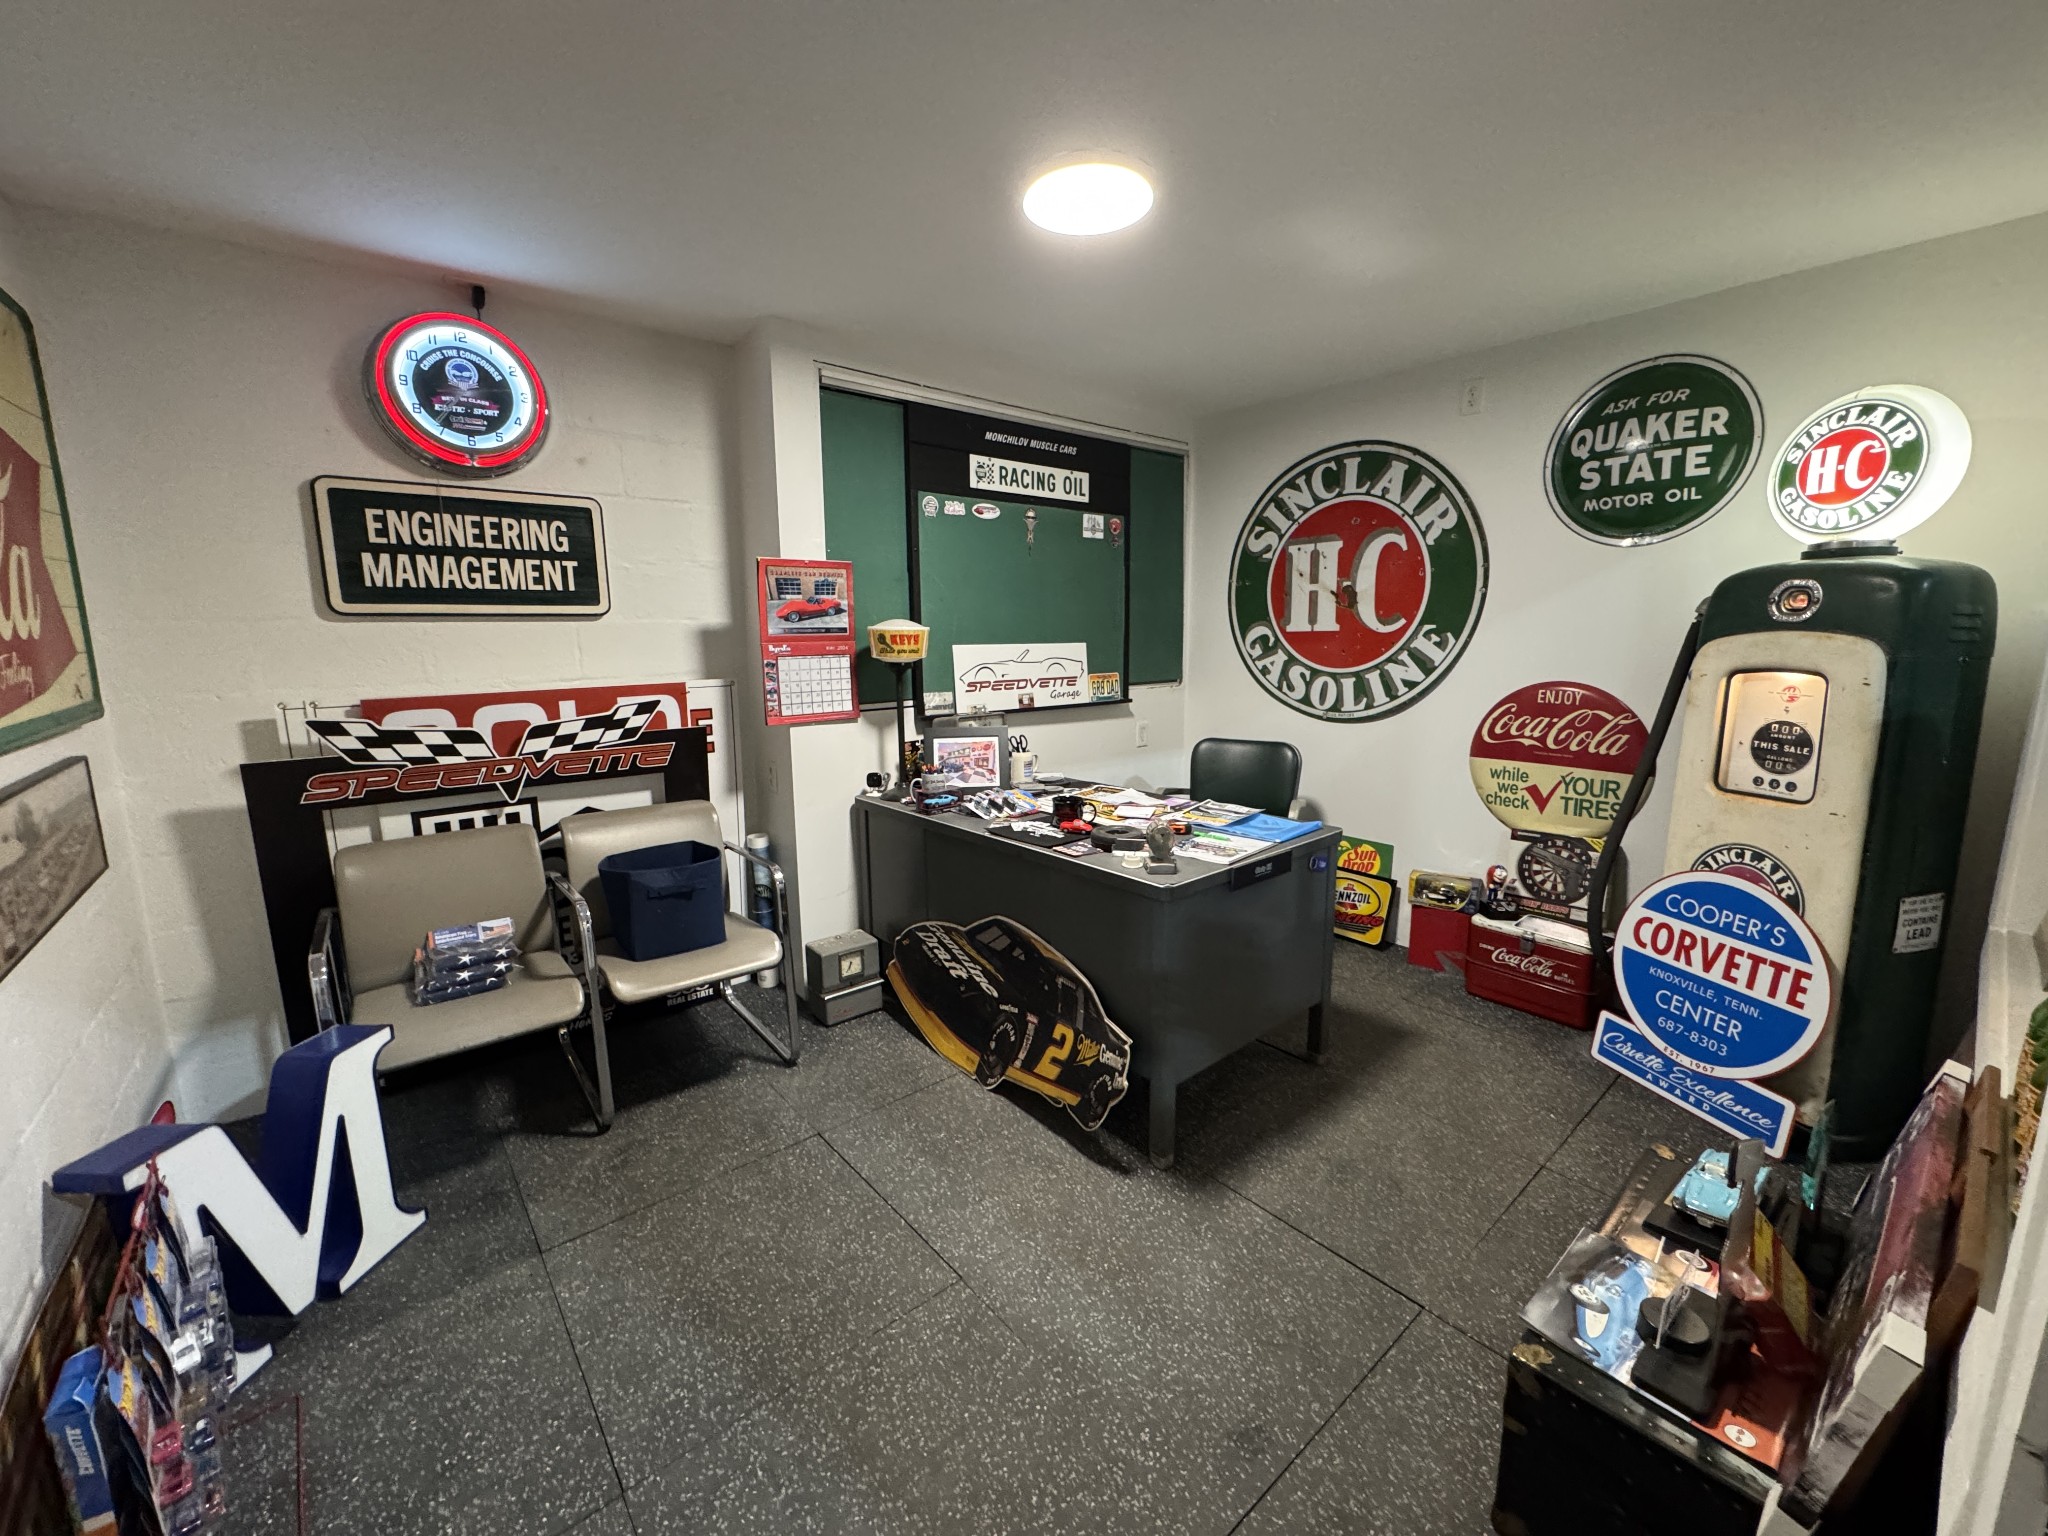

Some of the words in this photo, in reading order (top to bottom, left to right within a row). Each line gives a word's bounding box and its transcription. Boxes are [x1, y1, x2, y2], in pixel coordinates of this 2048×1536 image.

[428, 334, 437, 345] 11
[454, 331, 467, 343] 12
[406, 350, 419, 361] 10
[490, 345, 493, 355] 1
[420, 350, 444, 371] CRUISE
[442, 349, 458, 358] THE
[460, 350, 503, 382] CONCOURSE
[509, 366, 518, 377] 2
[399, 374, 408, 386] 9
[412, 403, 422, 414] 8
[473, 408, 500, 417] SPORT
[1601, 396, 1643, 417] ASK
[1646, 388, 1691, 406] FOR
[514, 417, 522, 426] 4
[1570, 406, 1730, 460] QUAKER
[467, 435, 476, 446] 6
[495, 432, 503, 442] 5
[985, 431, 1029, 447] MONCHILOV
[1030, 440, 1058, 452] MUSCLE
[1059, 445, 1078, 455] CARS
[1786, 405, 1918, 465] SINCLAIR
[1579, 444, 1713, 490] STATE
[1804, 439, 1886, 495] H-C
[999, 465, 1056, 492] RACING
[1063, 476, 1086, 497] OIL
[1247, 456, 1458, 560] SINCLAIR
[1583, 492, 1655, 512] MOTOR
[1665, 487, 1703, 503] OIL
[1780, 470, 1914, 529] GASOLINE
[364, 507, 570, 552] ENGINEERING
[361, 552, 578, 592] MANAGEMENT
[890, 633, 920, 646] KEYS
[1244, 624, 1456, 712] GASOLINE
[965, 676, 1078, 693] SPEEDVETTE
[1050, 689, 1082, 700] Garage
[1537, 689, 1583, 705] ENJOY
[1482, 703, 1640, 756] Coca-Cola
[1753, 740, 1779, 750] THIS
[1783, 744, 1810, 755] SALE
[301, 742, 675, 804] SPEEDVETTE
[1489, 766, 1529, 782] while
[1497, 782, 1518, 794] we
[1560, 775, 1621, 800] YOUR
[1486, 792, 1529, 810] check
[1348, 845, 1377, 861] Sun
[1665, 894, 1788, 947] COOPER'S
[1902, 915, 1938, 928] CONTAINS
[1906, 927, 1932, 940] LEAD
[915, 931, 969, 980] Draft
[1491, 947, 1556, 977] Coca-Cola
[1633, 917, 1813, 1010] CORVETTE
[687, 987, 714, 1001] ESTATE
[1649, 966, 1718, 1003] KNOXVILLE,
[1724, 996, 1763, 1021] TENN.
[1655, 989, 1742, 1042] CENTER
[1658, 1016, 1727, 1057] 687-8303
[1033, 1021, 1074, 1080] 2
[1663, 1046, 1684, 1063] EST.
[1689, 1060, 1715, 1074] 1967
[1603, 1032, 1666, 1072] Corvette
[1669, 1066, 1777, 1130] Excellence
